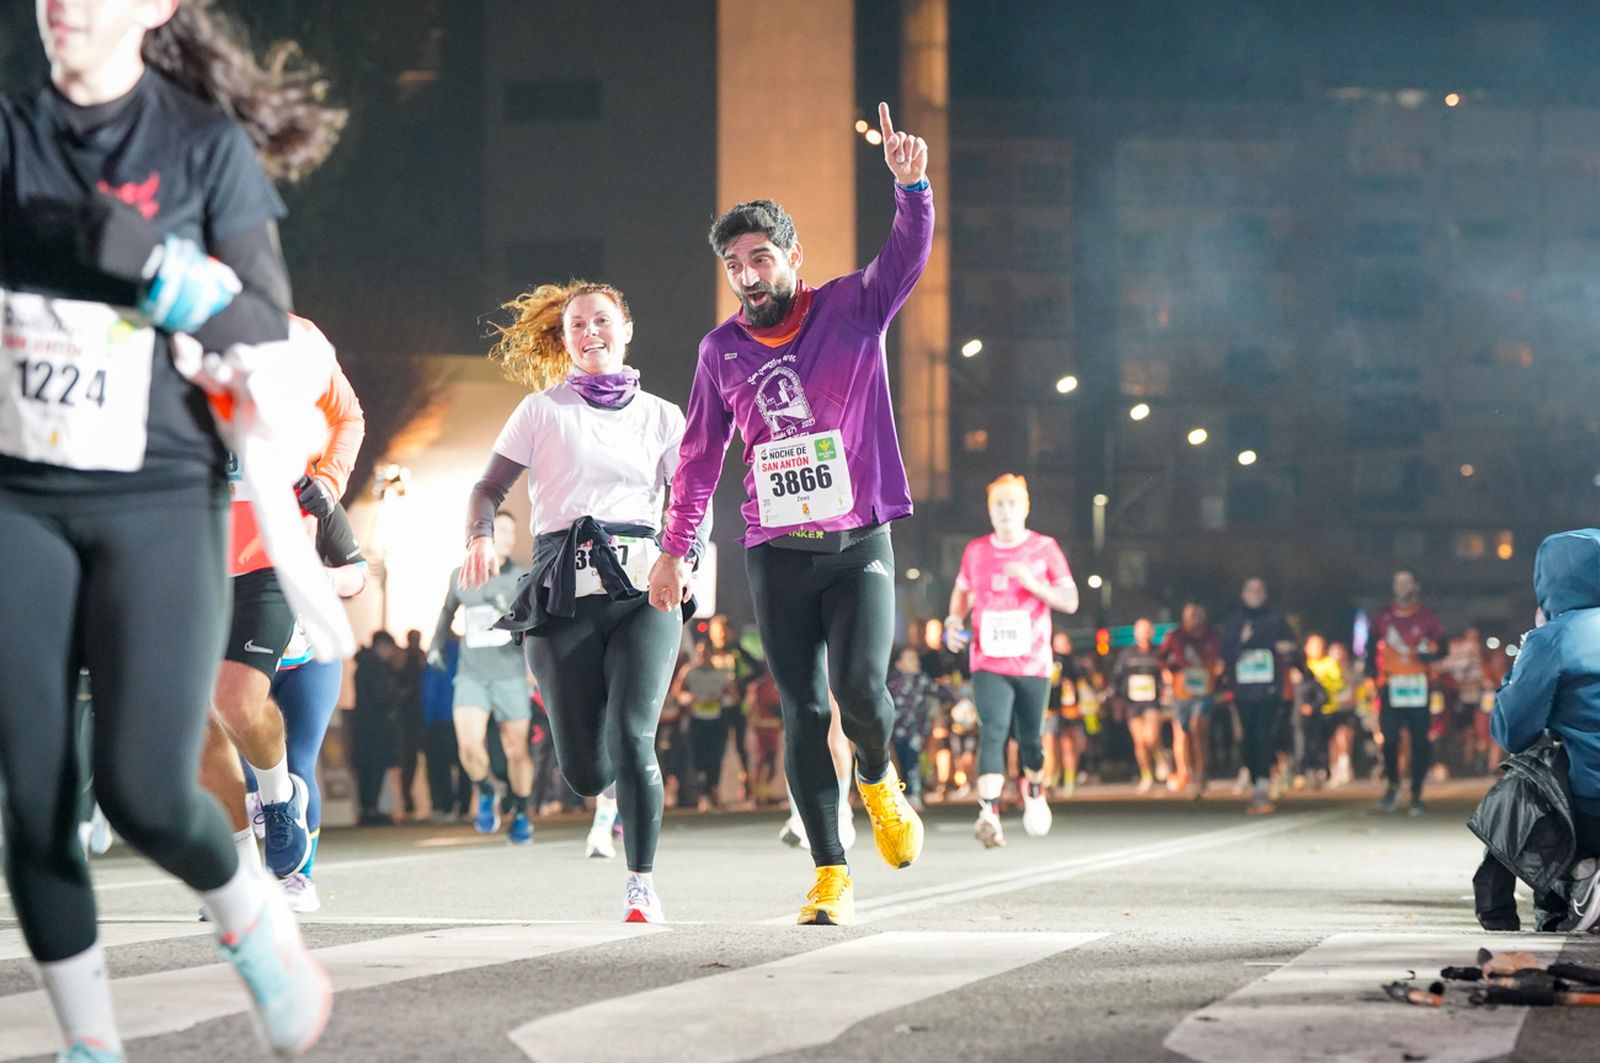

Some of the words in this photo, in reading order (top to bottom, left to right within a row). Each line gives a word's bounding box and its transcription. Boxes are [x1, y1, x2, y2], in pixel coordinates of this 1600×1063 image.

[16, 358, 106, 407] 1224
[769, 448, 795, 460] NOCHE
[796, 446, 807, 455] DE
[762, 462, 778, 472] SAN
[770, 464, 832, 497] 3866
